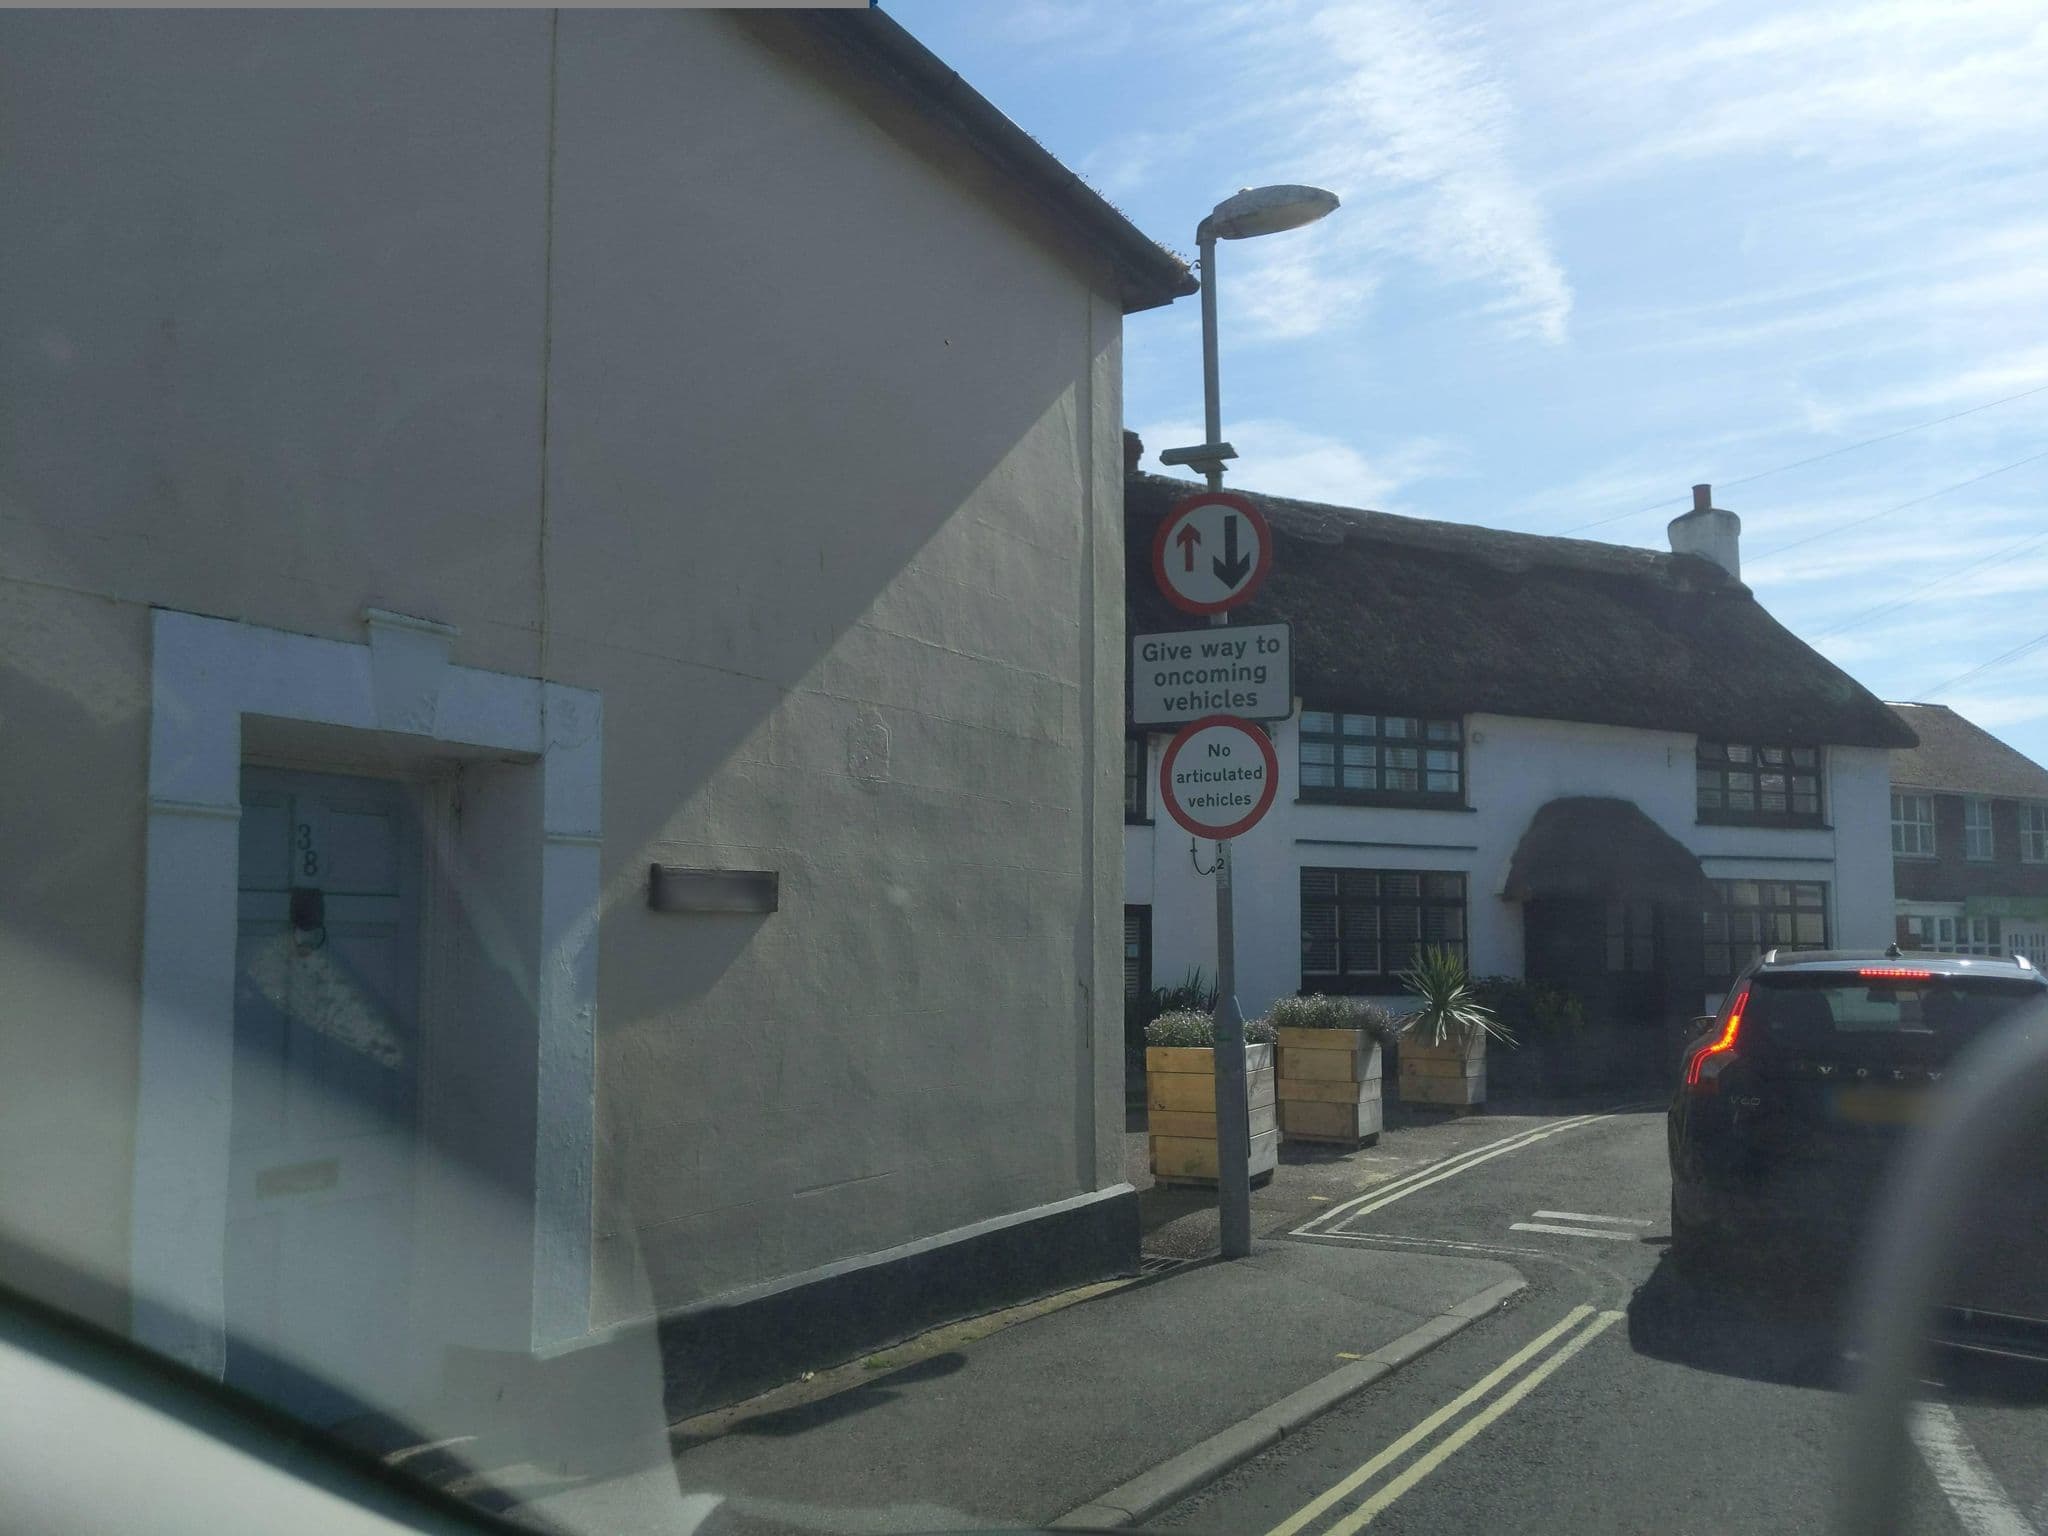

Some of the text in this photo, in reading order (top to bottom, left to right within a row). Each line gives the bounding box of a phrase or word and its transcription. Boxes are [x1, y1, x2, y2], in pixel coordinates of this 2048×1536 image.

[1142, 635, 1280, 663] Give way to
[1154, 663, 1267, 687] oncoming
[1163, 689, 1258, 712] vehicles
[1208, 744, 1231, 757] No
[1176, 766, 1263, 784] articulated
[1188, 793, 1252, 807] vehicles
